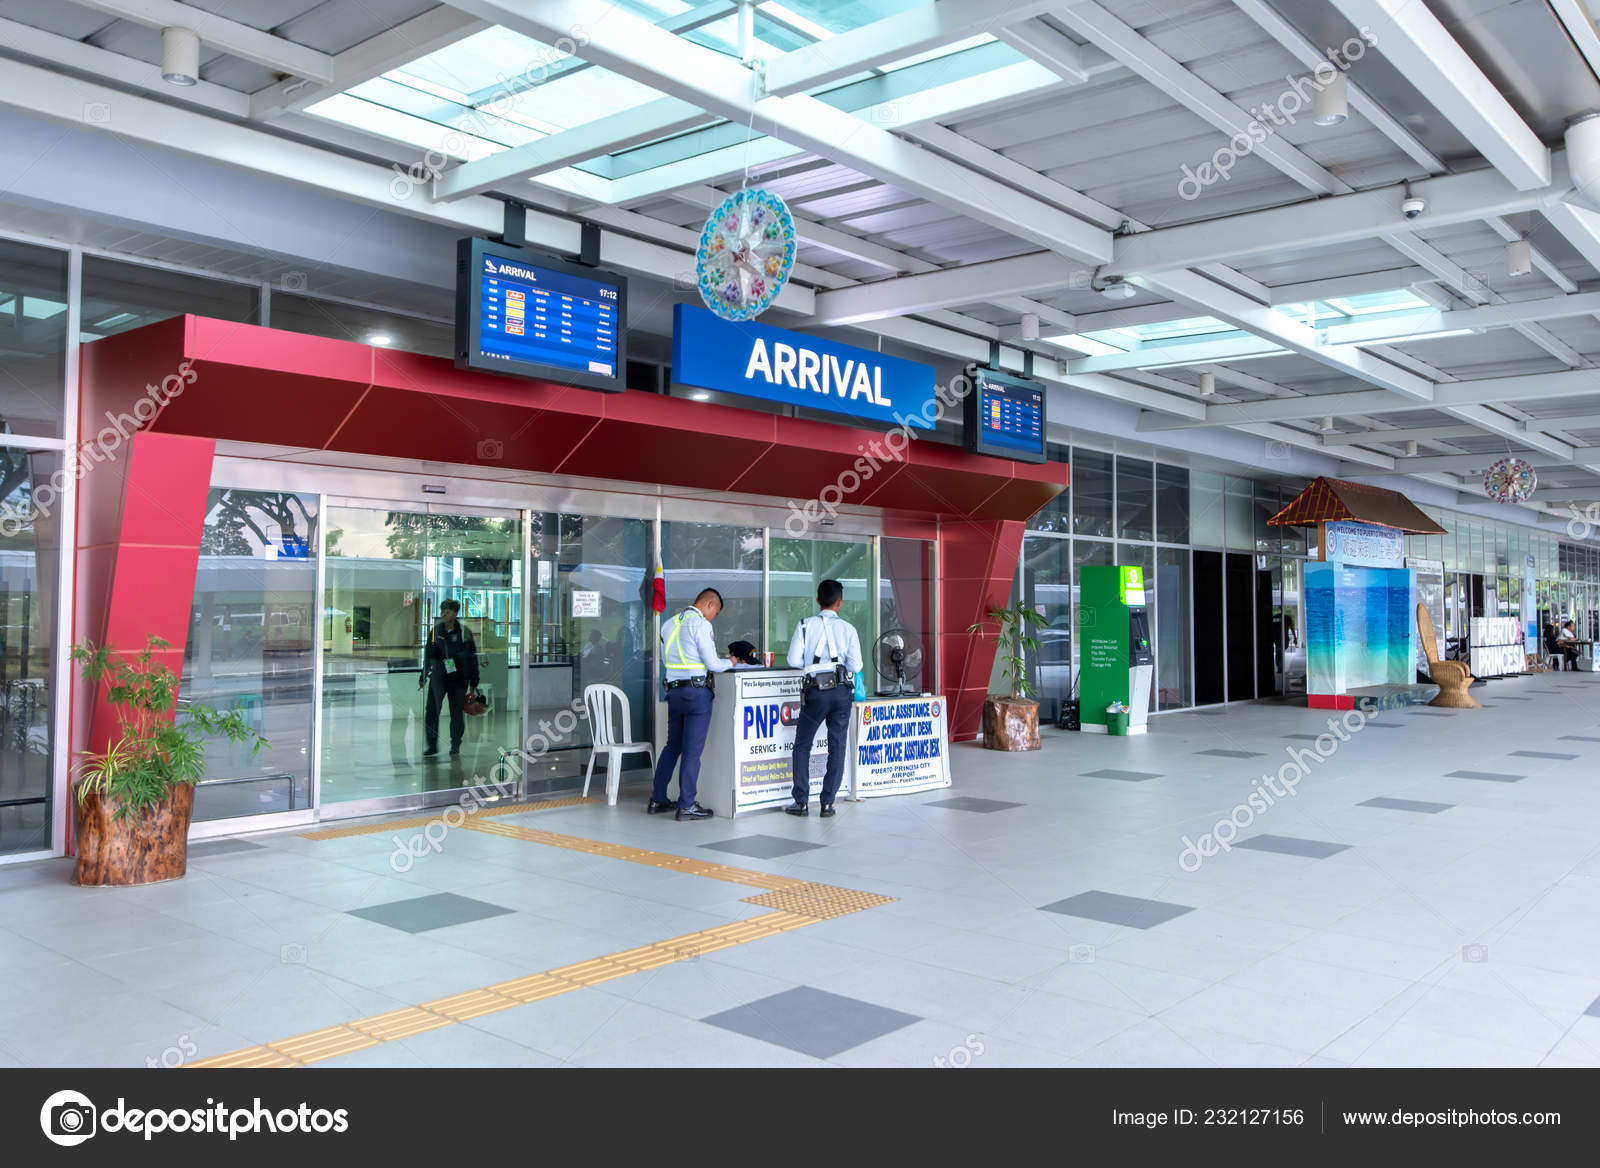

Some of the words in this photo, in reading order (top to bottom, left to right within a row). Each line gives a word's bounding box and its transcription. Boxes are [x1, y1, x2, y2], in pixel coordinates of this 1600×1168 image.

[499, 264, 537, 281] ARRIVAL
[600, 288, 617, 299] 17:12
[745, 338, 891, 407] ARRIVAL
[1479, 616, 1517, 646] PUERTO
[1479, 645, 1526, 678] PRINCESA
[743, 704, 780, 739] PNP
[872, 705, 895, 722] PUBLIC
[895, 702, 930, 720] ASSISTANCE
[866, 725, 880, 741] AND
[918, 720, 932, 736] DESK
[750, 744, 777, 755] SERVICE
[859, 744, 883, 766] TOURIST
[885, 742, 902, 763] POLICE
[871, 766, 893, 774] PUERTO
[894, 763, 919, 772] PRINCESA
